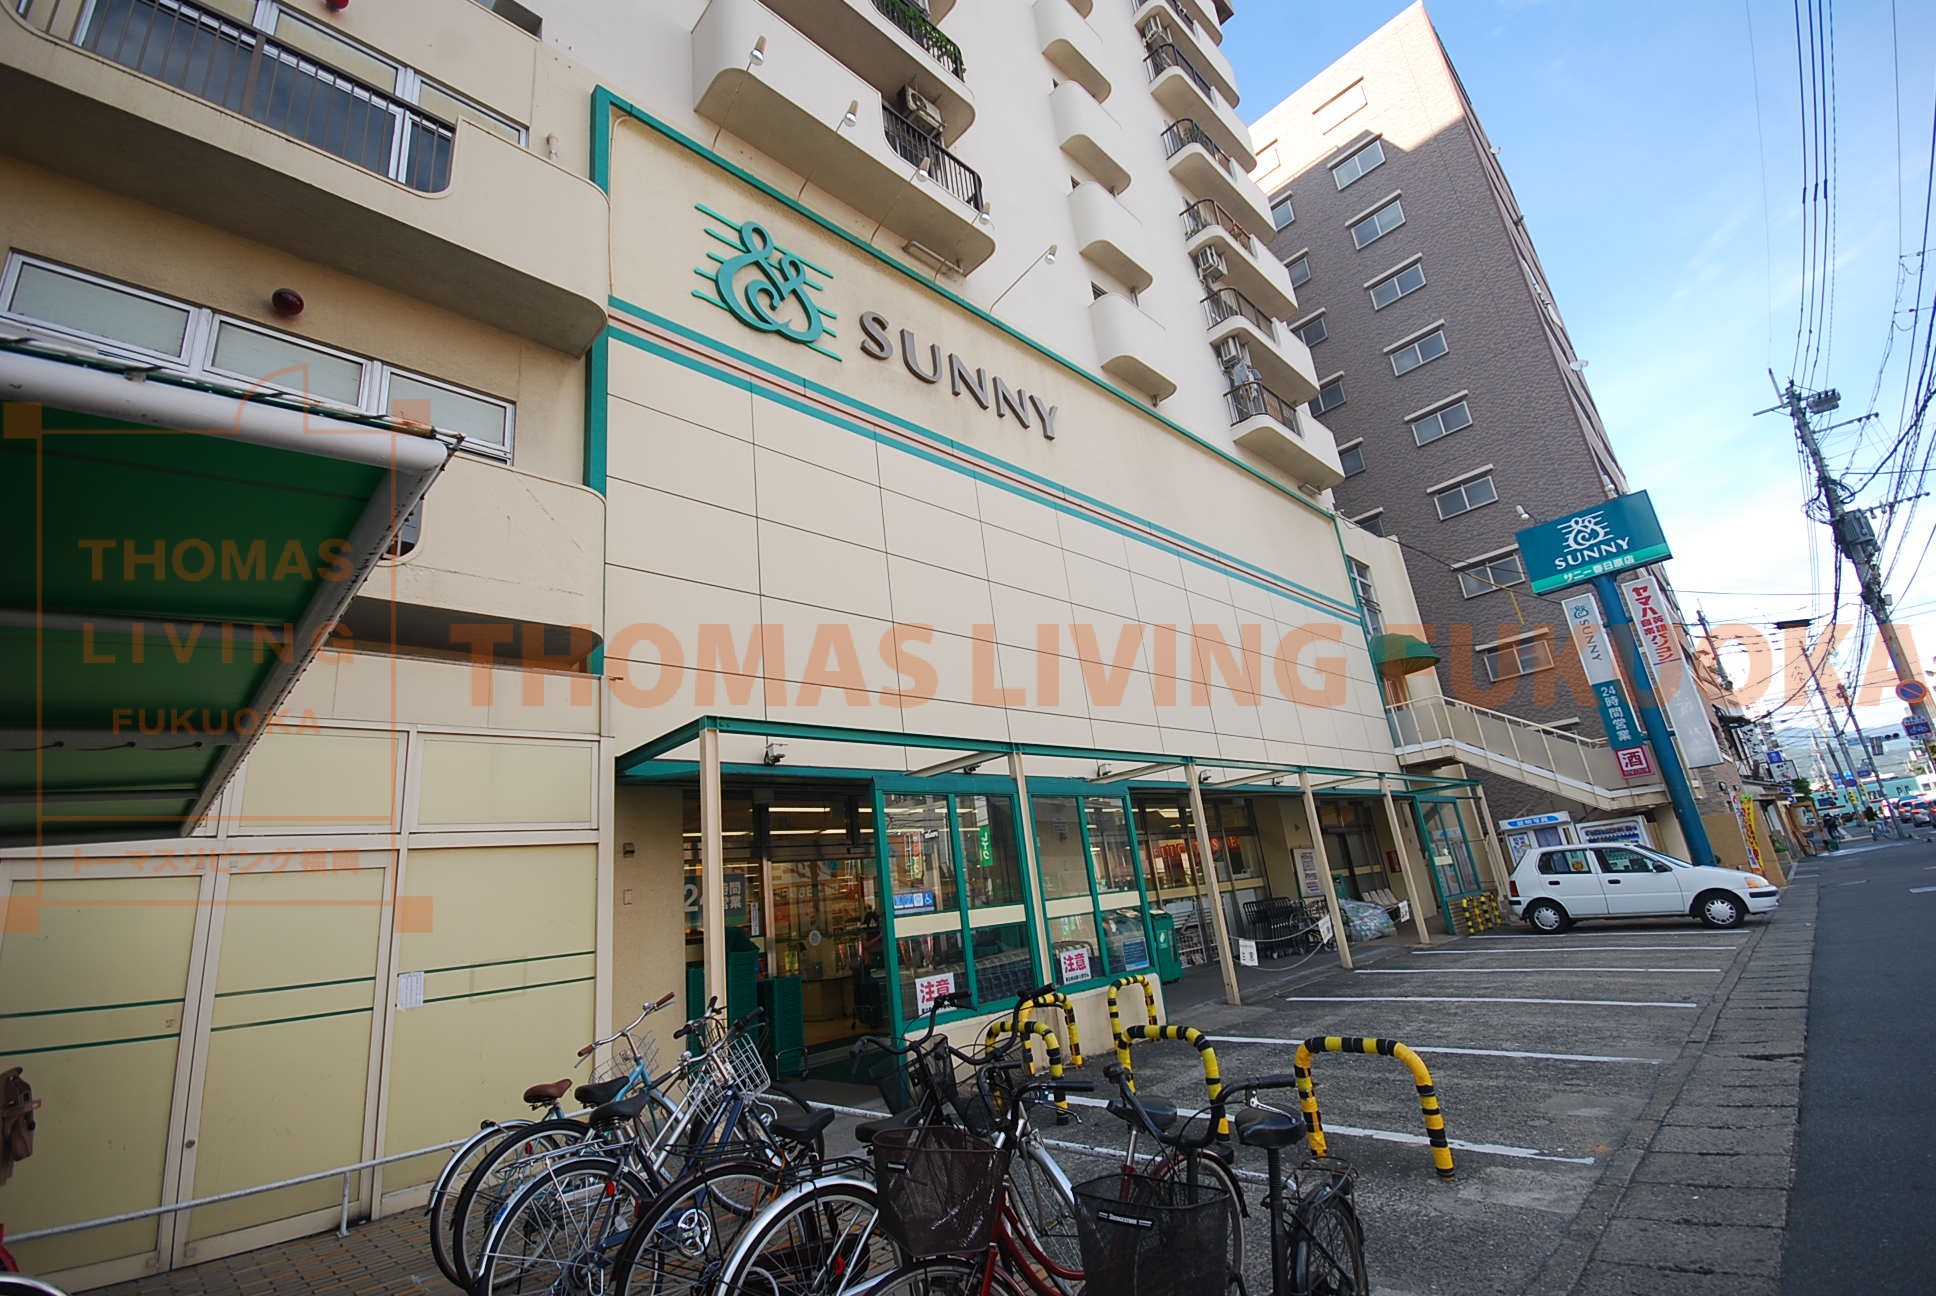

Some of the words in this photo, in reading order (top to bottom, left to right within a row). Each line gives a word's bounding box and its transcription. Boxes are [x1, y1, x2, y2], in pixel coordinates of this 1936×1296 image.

[860, 311, 1058, 440] SUNNY
[1555, 537, 1630, 570] SUNNY
[1631, 585, 1659, 618] ヤマハ
[1579, 620, 1603, 661] SUNNY
[1621, 750, 1644, 768] 酒
[1063, 953, 1088, 973] 注意
[920, 978, 950, 1004] 注意
